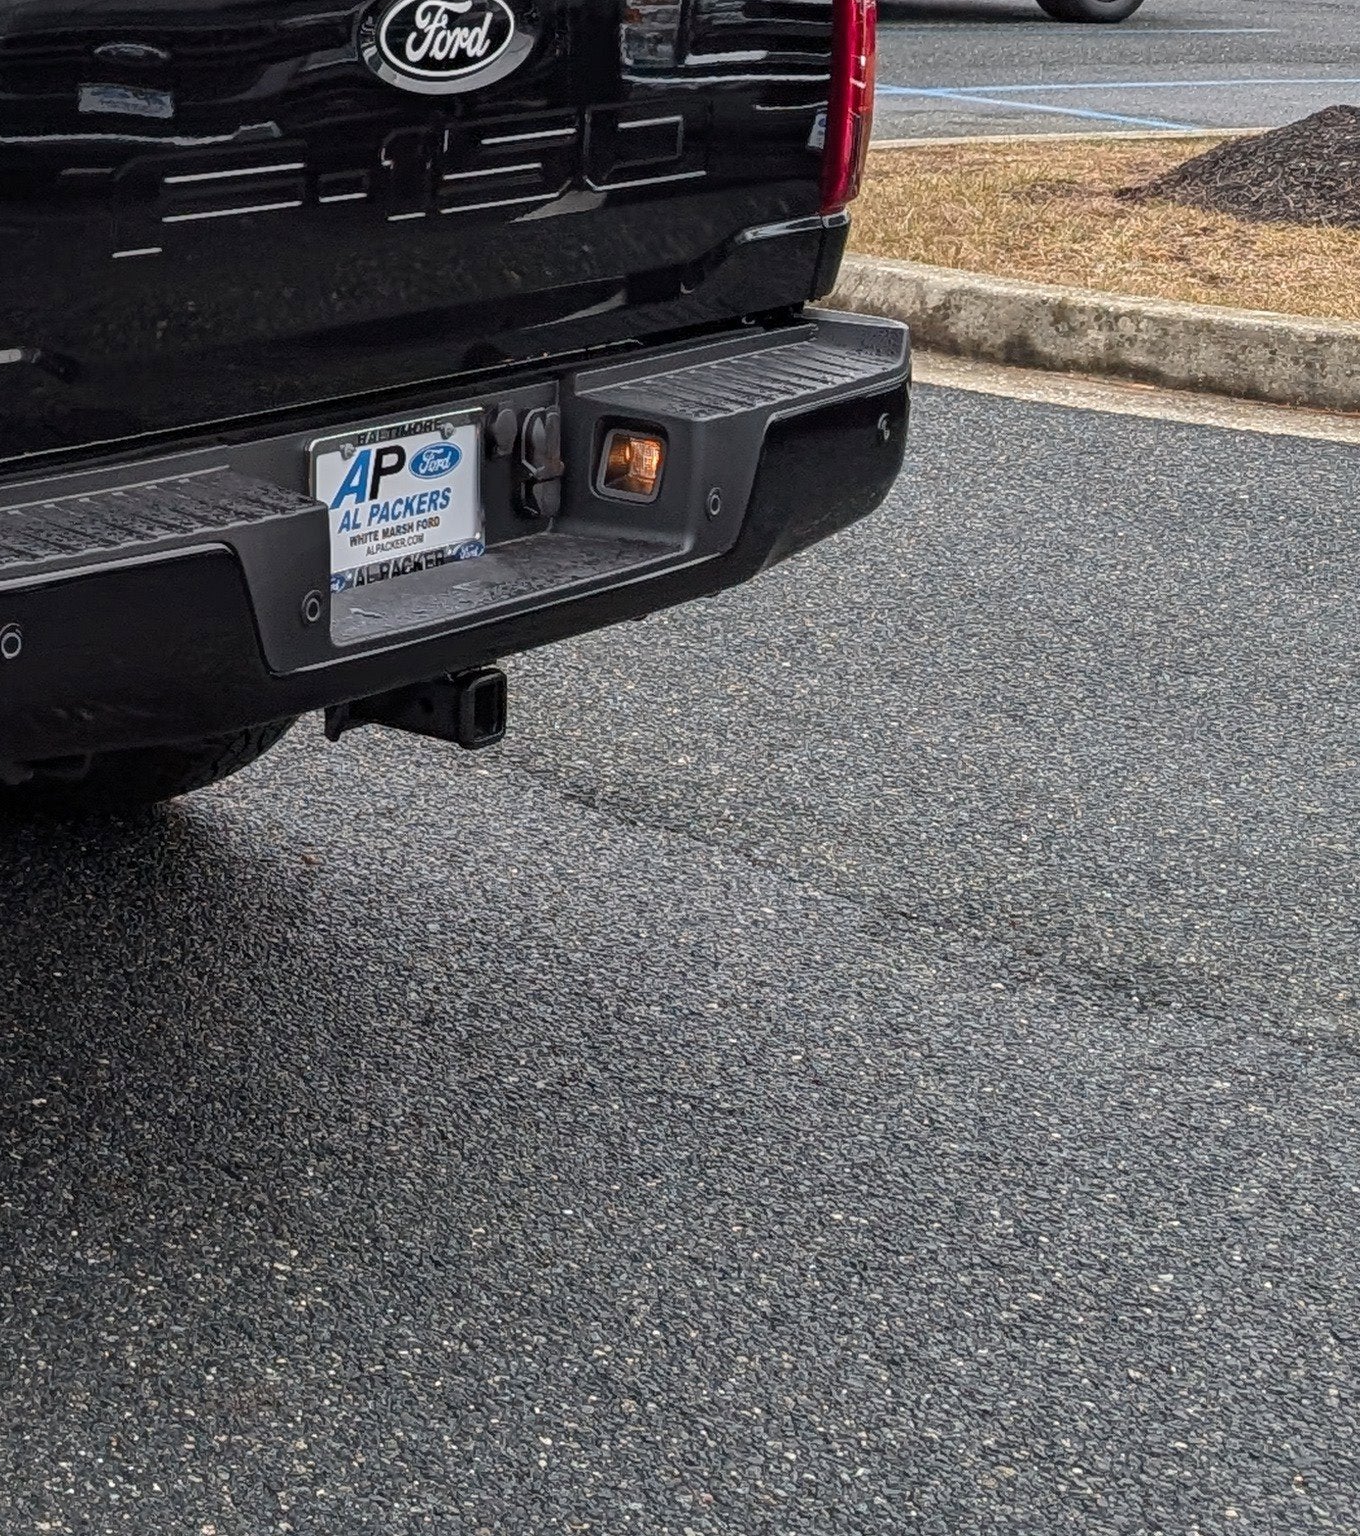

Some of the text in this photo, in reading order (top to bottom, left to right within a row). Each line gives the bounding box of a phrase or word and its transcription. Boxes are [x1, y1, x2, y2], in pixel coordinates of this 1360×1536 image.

[406, 0, 493, 62] Ford
[358, 419, 442, 446] BALTIMORE
[330, 445, 406, 511] AP
[337, 487, 452, 534] AL PACKERS
[349, 515, 441, 547] WHITE MARSH FORD
[366, 533, 425, 557] ALPACKER.COM
[379, 549, 445, 580] PACKER
